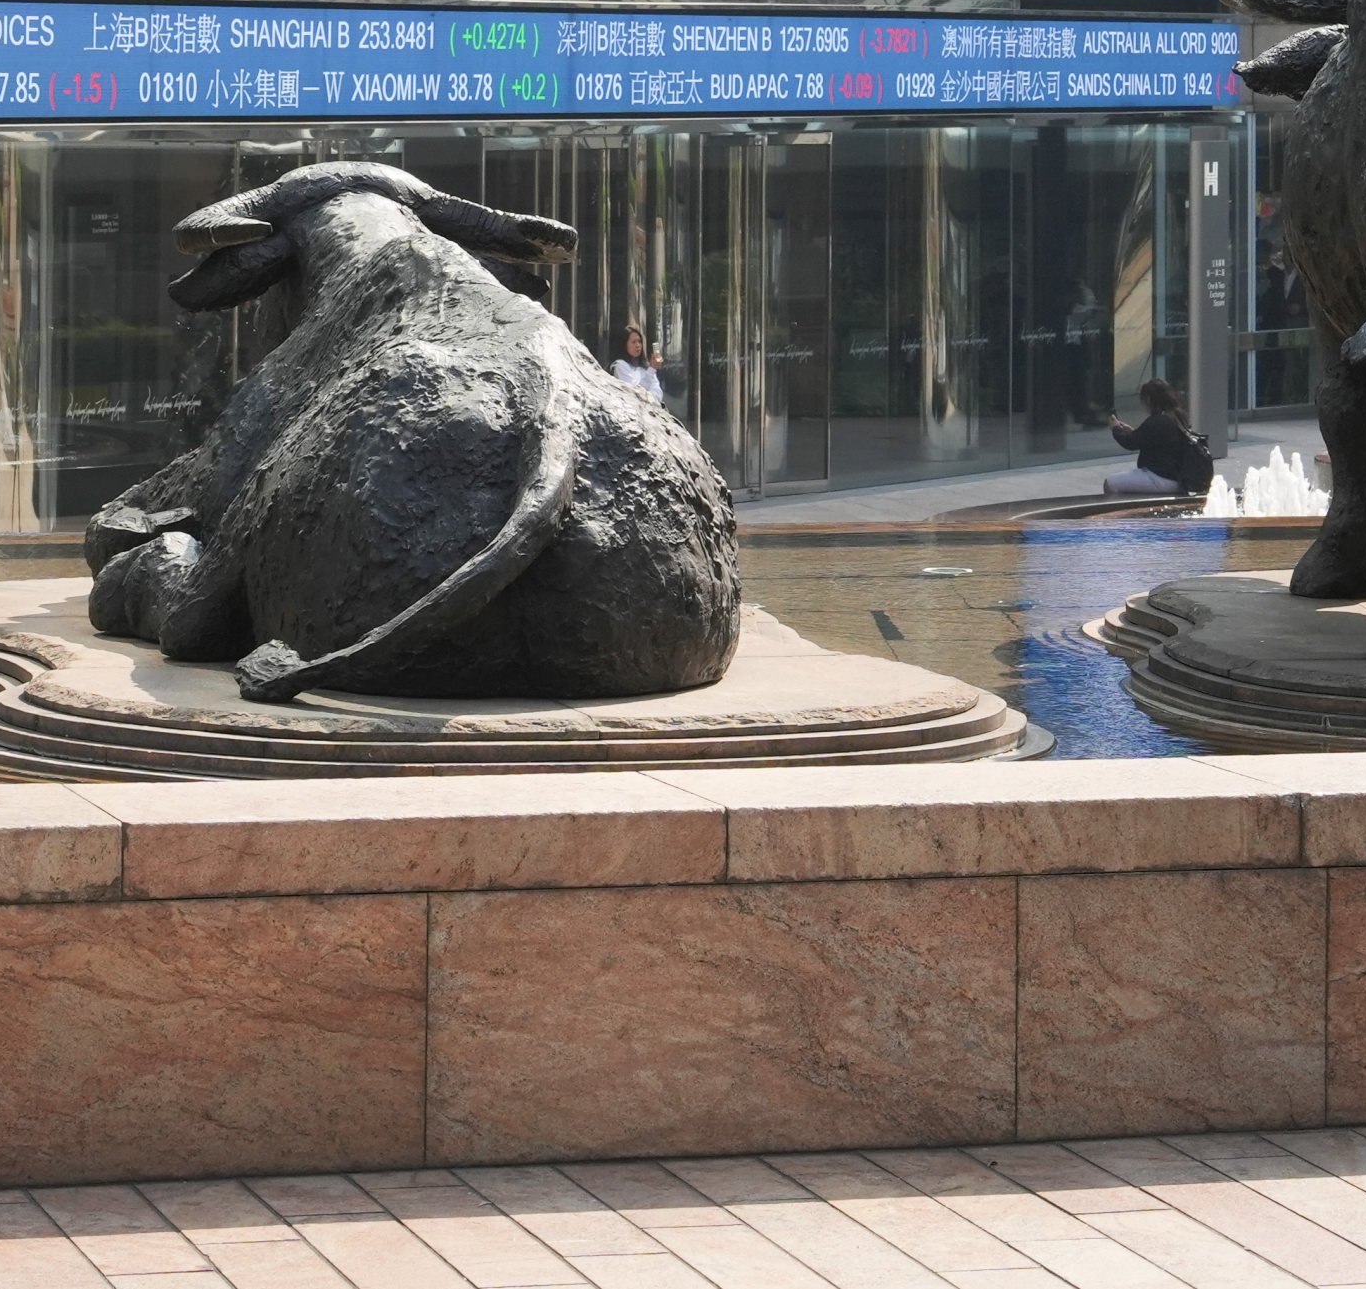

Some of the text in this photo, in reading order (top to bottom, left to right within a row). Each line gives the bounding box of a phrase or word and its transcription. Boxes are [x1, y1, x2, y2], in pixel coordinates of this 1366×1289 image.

[83, 12, 221, 54] 上海B股指數
[229, 18, 332, 48] SHANGHAI
[337, 22, 350, 48] B
[359, 20, 435, 50] 253.8481
[556, 20, 665, 57] 深圳B股指數
[672, 25, 758, 52] SHENZHEN
[761, 27, 772, 52] B
[779, 26, 849, 53] 1257.6905
[941, 25, 1077, 59] 澳洲所有普通股指數
[1083, 31, 1151, 54] AUSTRALIA
[1155, 32, 1177, 54] ALL
[1180, 32, 1207, 54] ORD
[139, 72, 197, 104] 01810
[351, 73, 441, 102] XIAOMI-W
[447, 73, 493, 102] 38.78
[575, 73, 623, 100] 01876
[629, 70, 703, 106] 百威亞太
[710, 74, 743, 100] BUD
[746, 74, 789, 100] APAC
[795, 74, 824, 99] 7.68
[897, 73, 935, 98] 01928
[941, 69, 1060, 103] 金沙中國有限公司
[1067, 73, 1110, 96] SANDS
[1113, 73, 1149, 96] CHINA
[1154, 73, 1177, 96] LTD
[1184, 73, 1212, 96] 19.42
